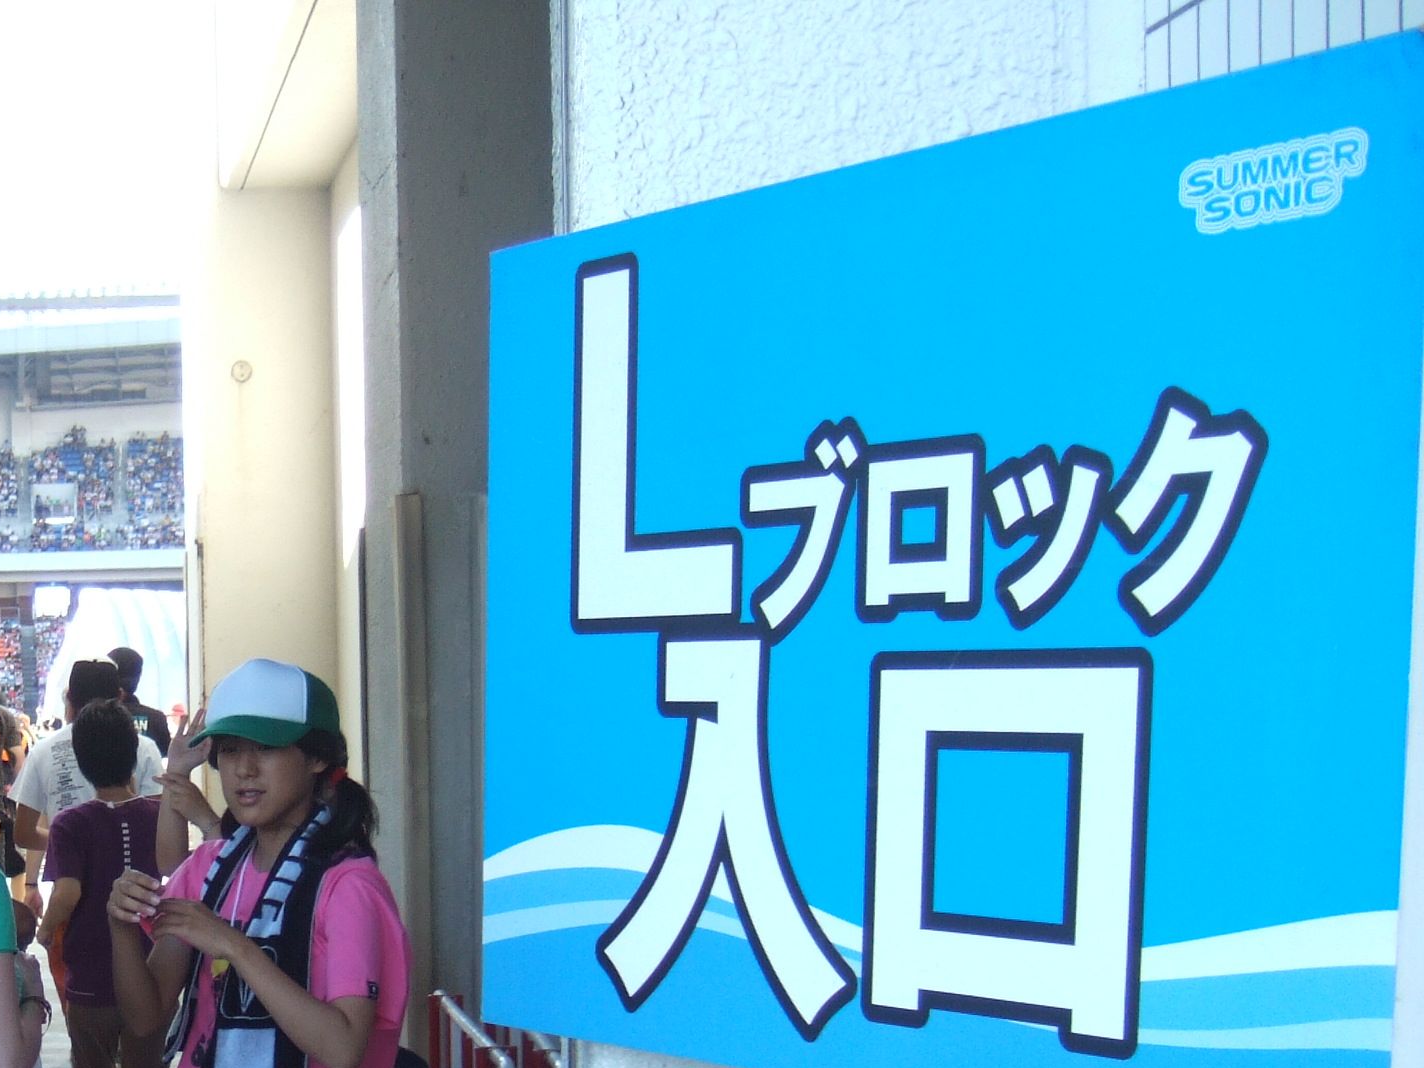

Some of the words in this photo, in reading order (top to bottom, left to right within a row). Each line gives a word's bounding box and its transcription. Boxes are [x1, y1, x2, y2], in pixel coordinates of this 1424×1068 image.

[1187, 138, 1359, 197] SUMMER
[1204, 175, 1335, 223] SONIC
[598, 627, 1153, 1060] 入口
